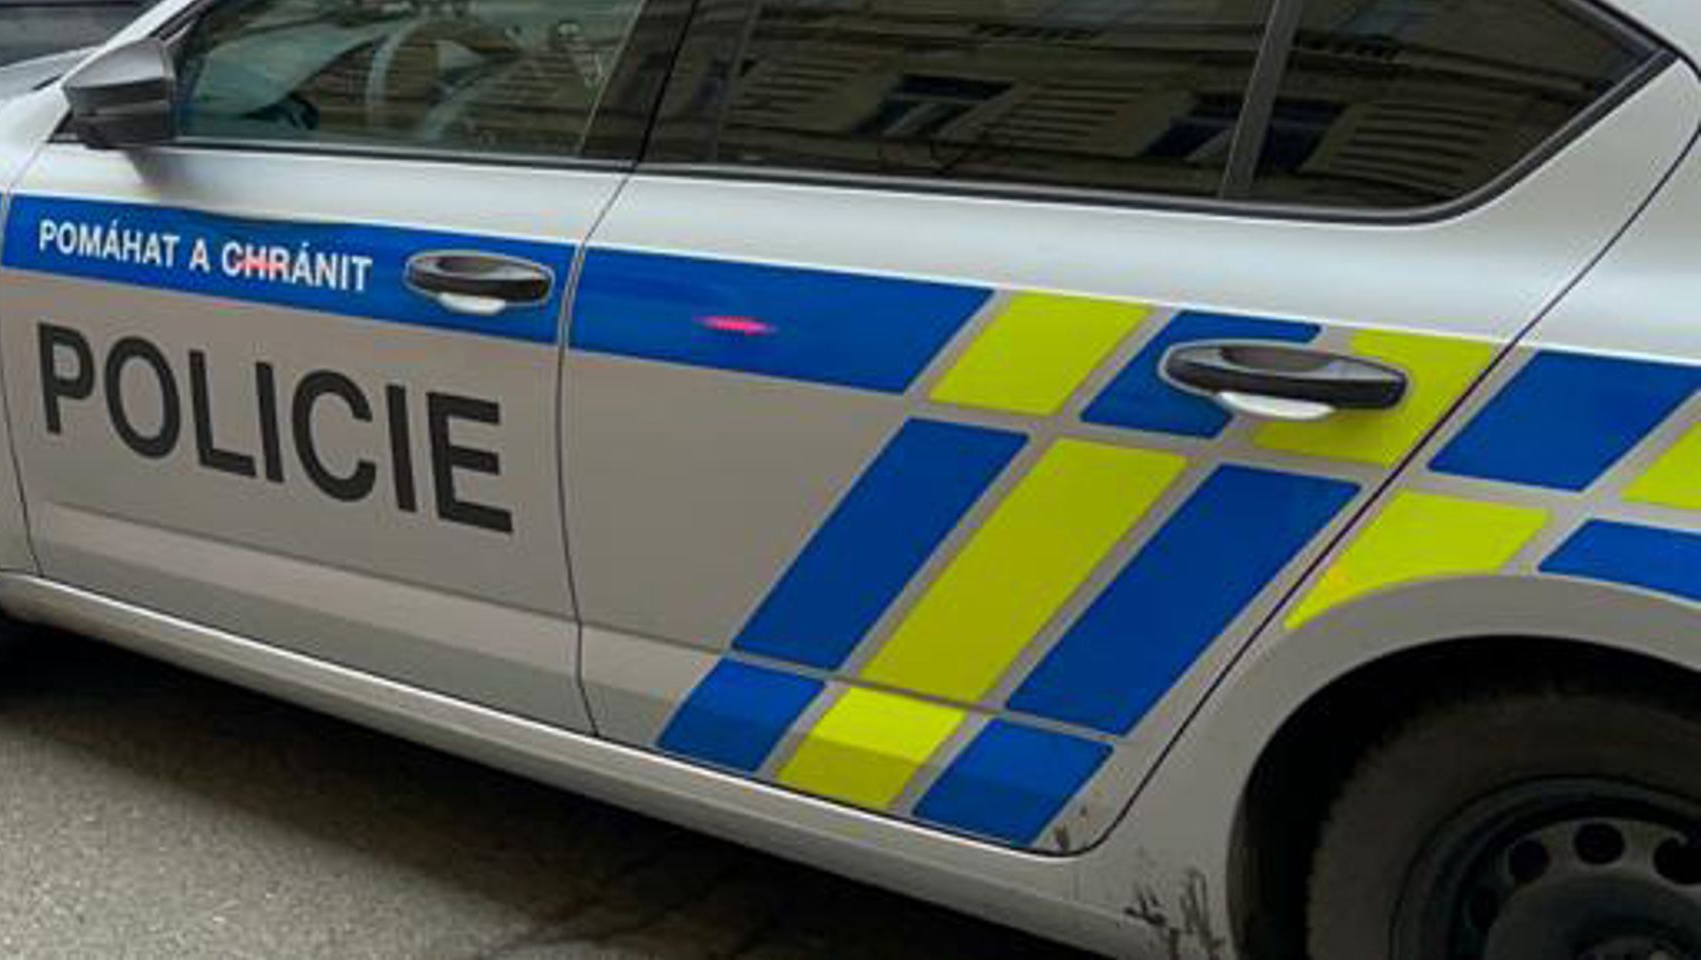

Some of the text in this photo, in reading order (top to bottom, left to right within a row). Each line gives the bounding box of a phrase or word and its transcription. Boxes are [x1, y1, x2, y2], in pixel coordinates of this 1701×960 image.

[39, 219, 373, 292] POMÁHAT A CHRÁNIT
[37, 321, 513, 533] POLICIE
